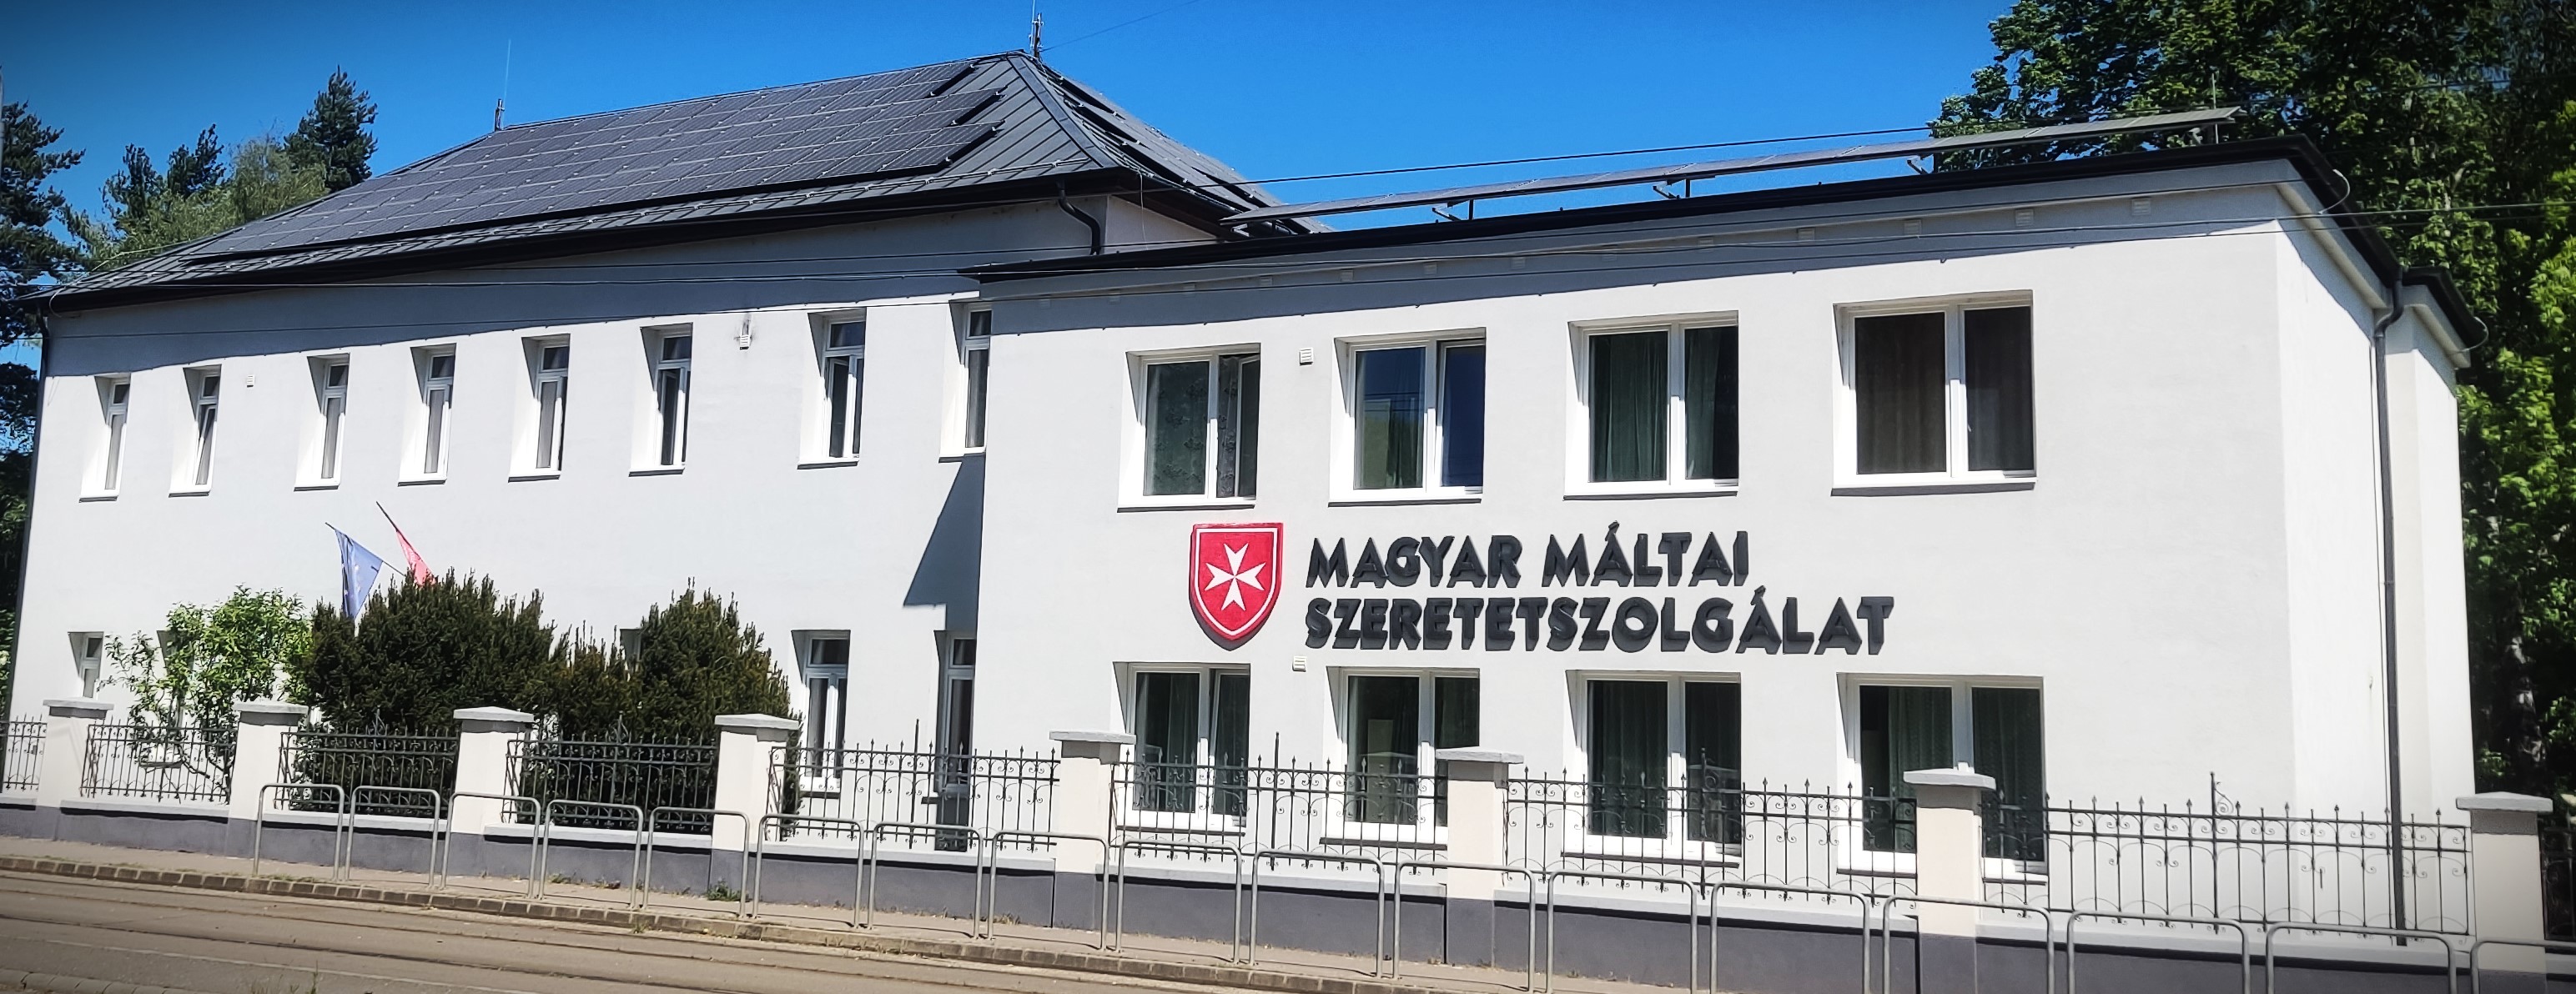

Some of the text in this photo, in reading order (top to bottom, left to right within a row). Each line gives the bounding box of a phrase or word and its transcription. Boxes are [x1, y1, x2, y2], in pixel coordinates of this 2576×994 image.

[1306, 521, 1749, 589] MAGYAR MÁLTAI
[1305, 585, 1894, 655] SZERETETSZOLGÁLAT
